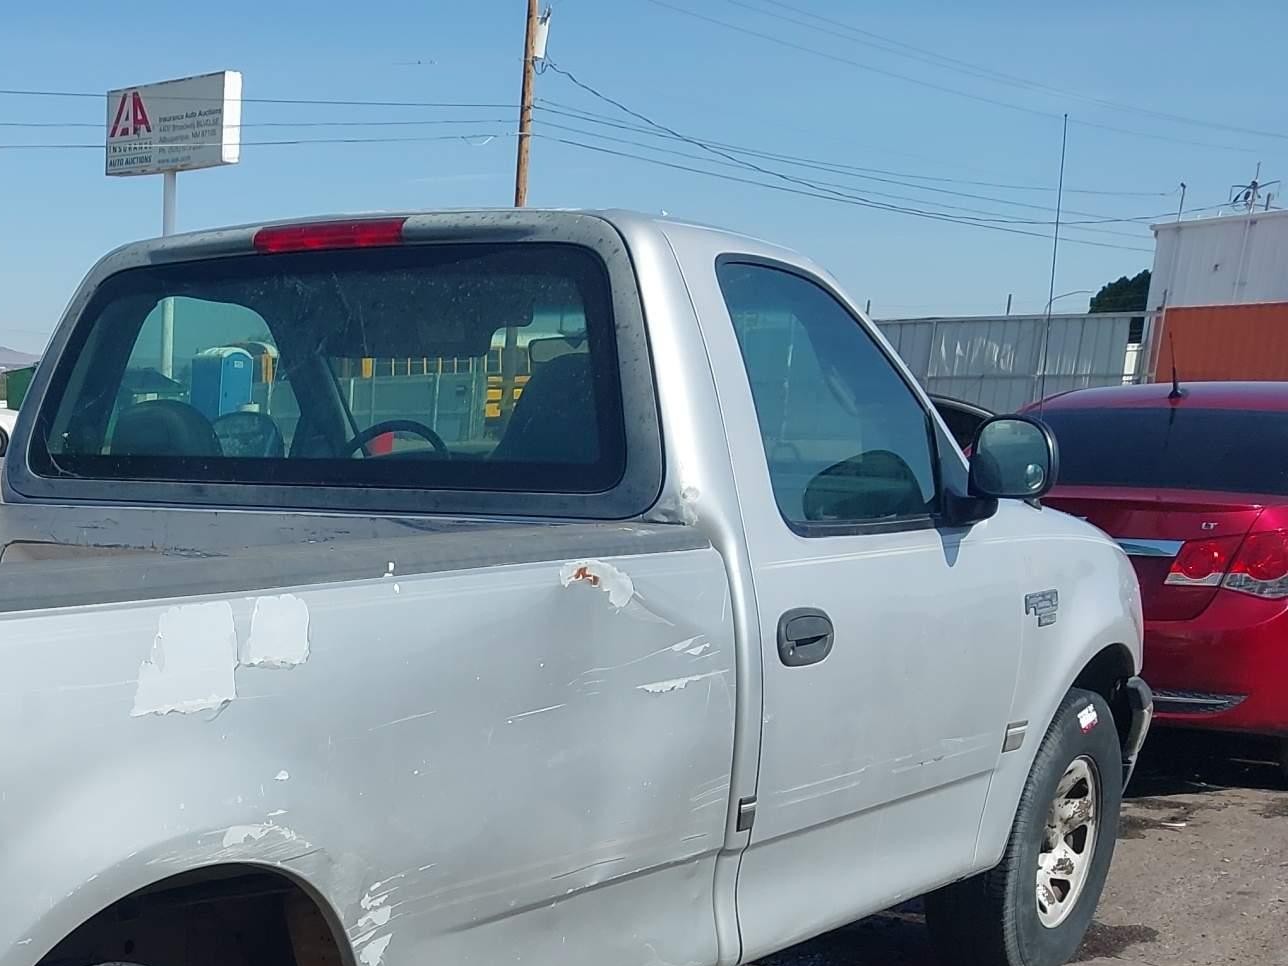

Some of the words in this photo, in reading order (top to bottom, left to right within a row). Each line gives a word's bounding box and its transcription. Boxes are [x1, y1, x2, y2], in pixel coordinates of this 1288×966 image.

[185, 111, 197, 120] Auto
[108, 157, 124, 168] AUTO
[124, 154, 152, 166] AUCTIONS
[1201, 522, 1219, 530] LT
